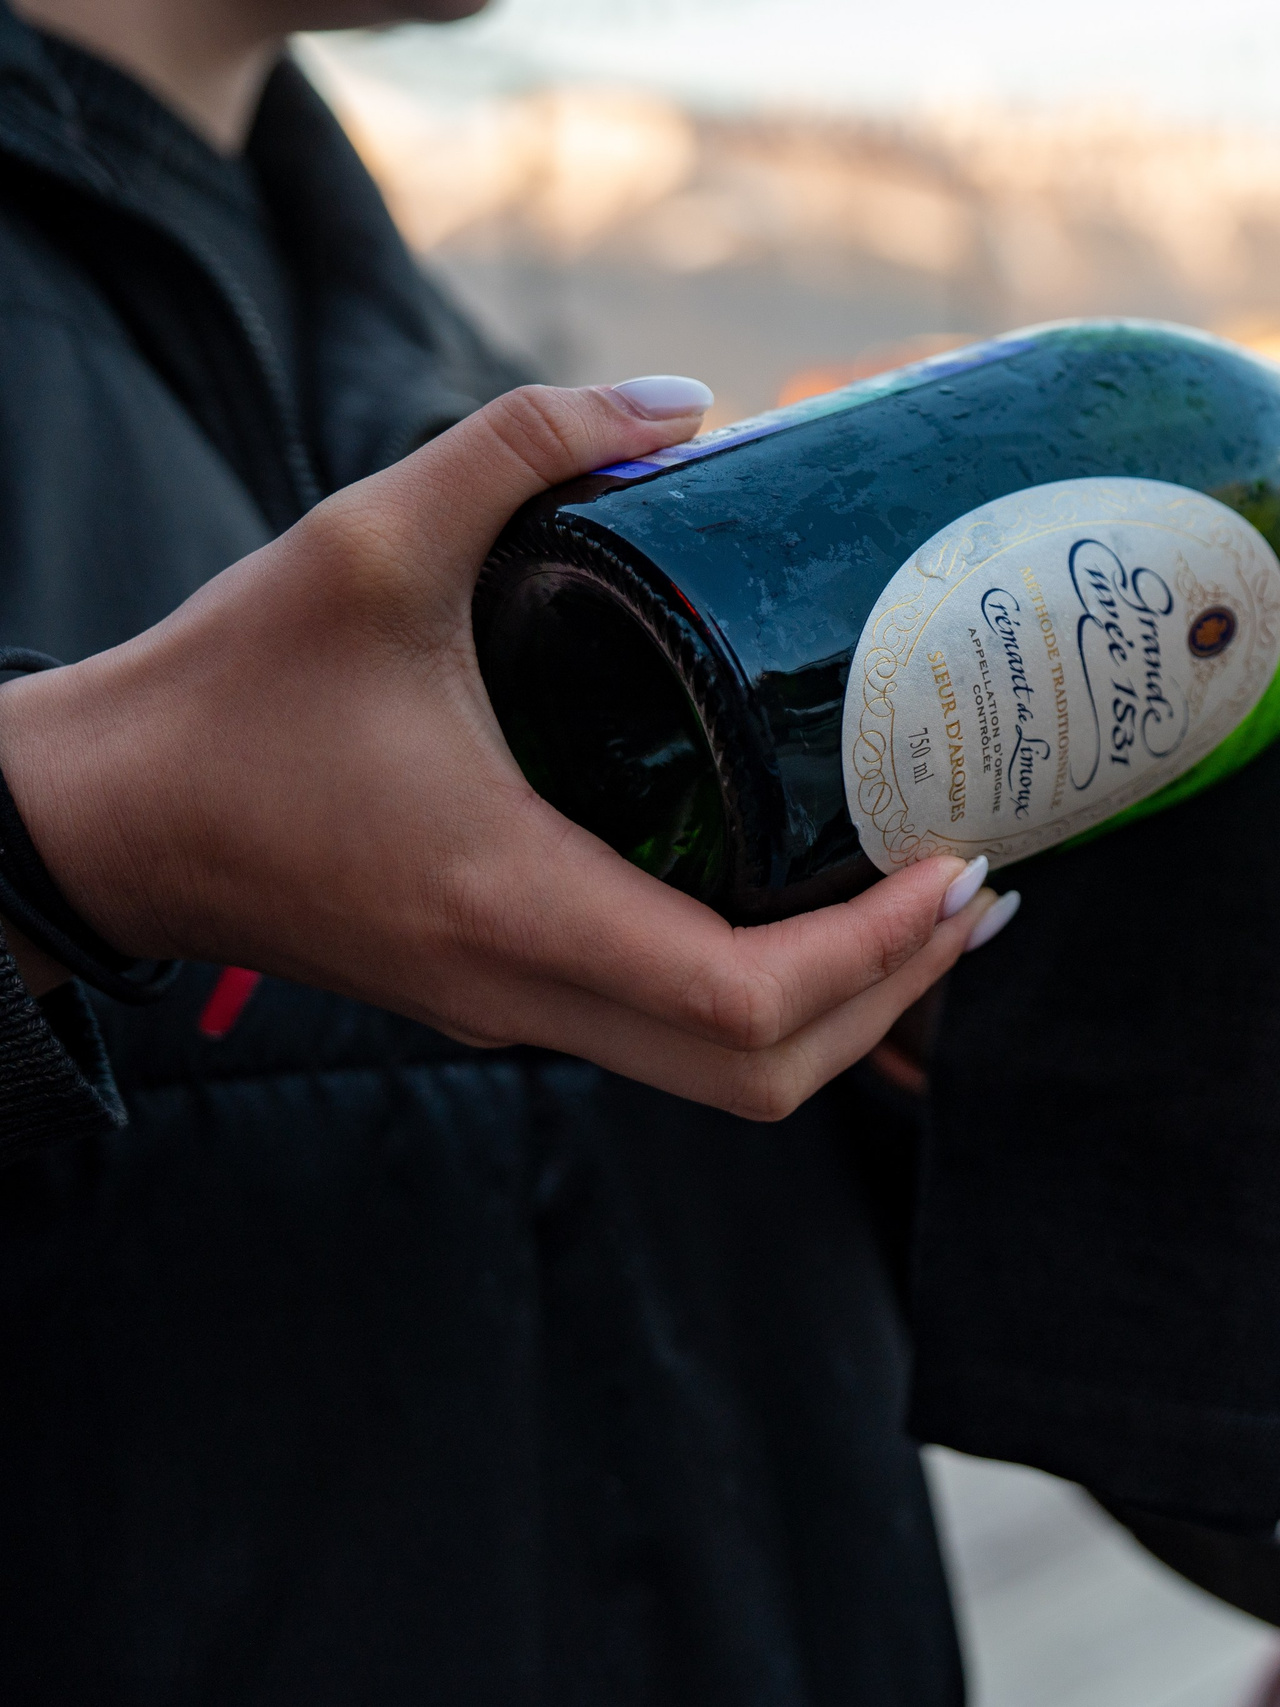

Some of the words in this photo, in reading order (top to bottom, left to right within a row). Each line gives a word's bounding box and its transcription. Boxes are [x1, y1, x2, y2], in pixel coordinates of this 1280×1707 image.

[981, 587, 1035, 704] Crémant
[1019, 565, 1061, 661] MÉTHODE
[1068, 538, 1135, 668] Cuvée
[1110, 677, 1139, 767] 1831
[1113, 566, 1190, 759] Grande
[908, 727, 932, 759] 750
[927, 650, 957, 719] SIEUR
[945, 719, 967, 823] D'ARQUES
[968, 627, 1000, 738] APPELLATION
[992, 742, 1003, 814] D'ORIGINE
[972, 684, 993, 774] CONTRÔLÉE
[1016, 702, 1034, 724] de
[913, 762, 935, 785] ml
[1008, 724, 1051, 820] Limoux
